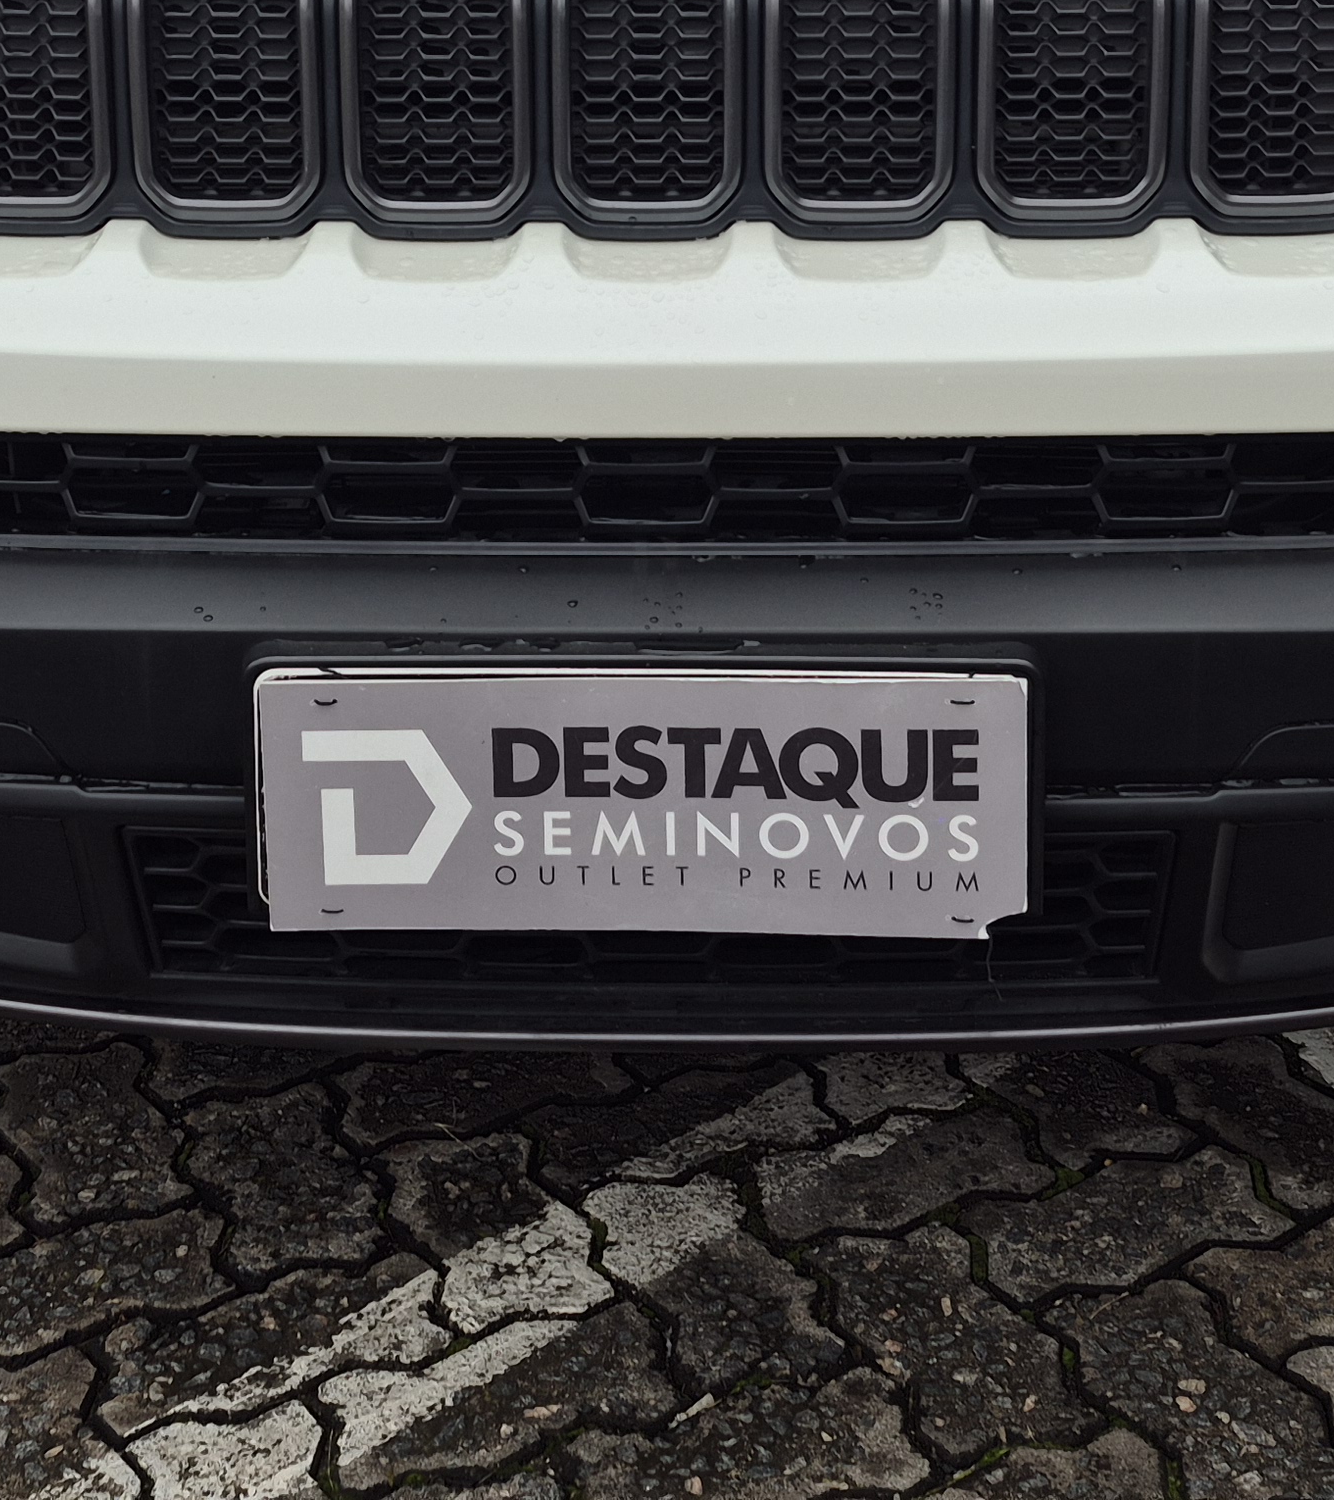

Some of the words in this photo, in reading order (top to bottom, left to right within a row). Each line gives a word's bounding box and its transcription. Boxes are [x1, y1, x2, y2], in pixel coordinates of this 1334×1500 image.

[491, 726, 980, 808] DESTAQUE
[494, 810, 981, 863] SEMINOVOS
[495, 864, 690, 888] OUTLET
[740, 866, 980, 892] PREMIUM
